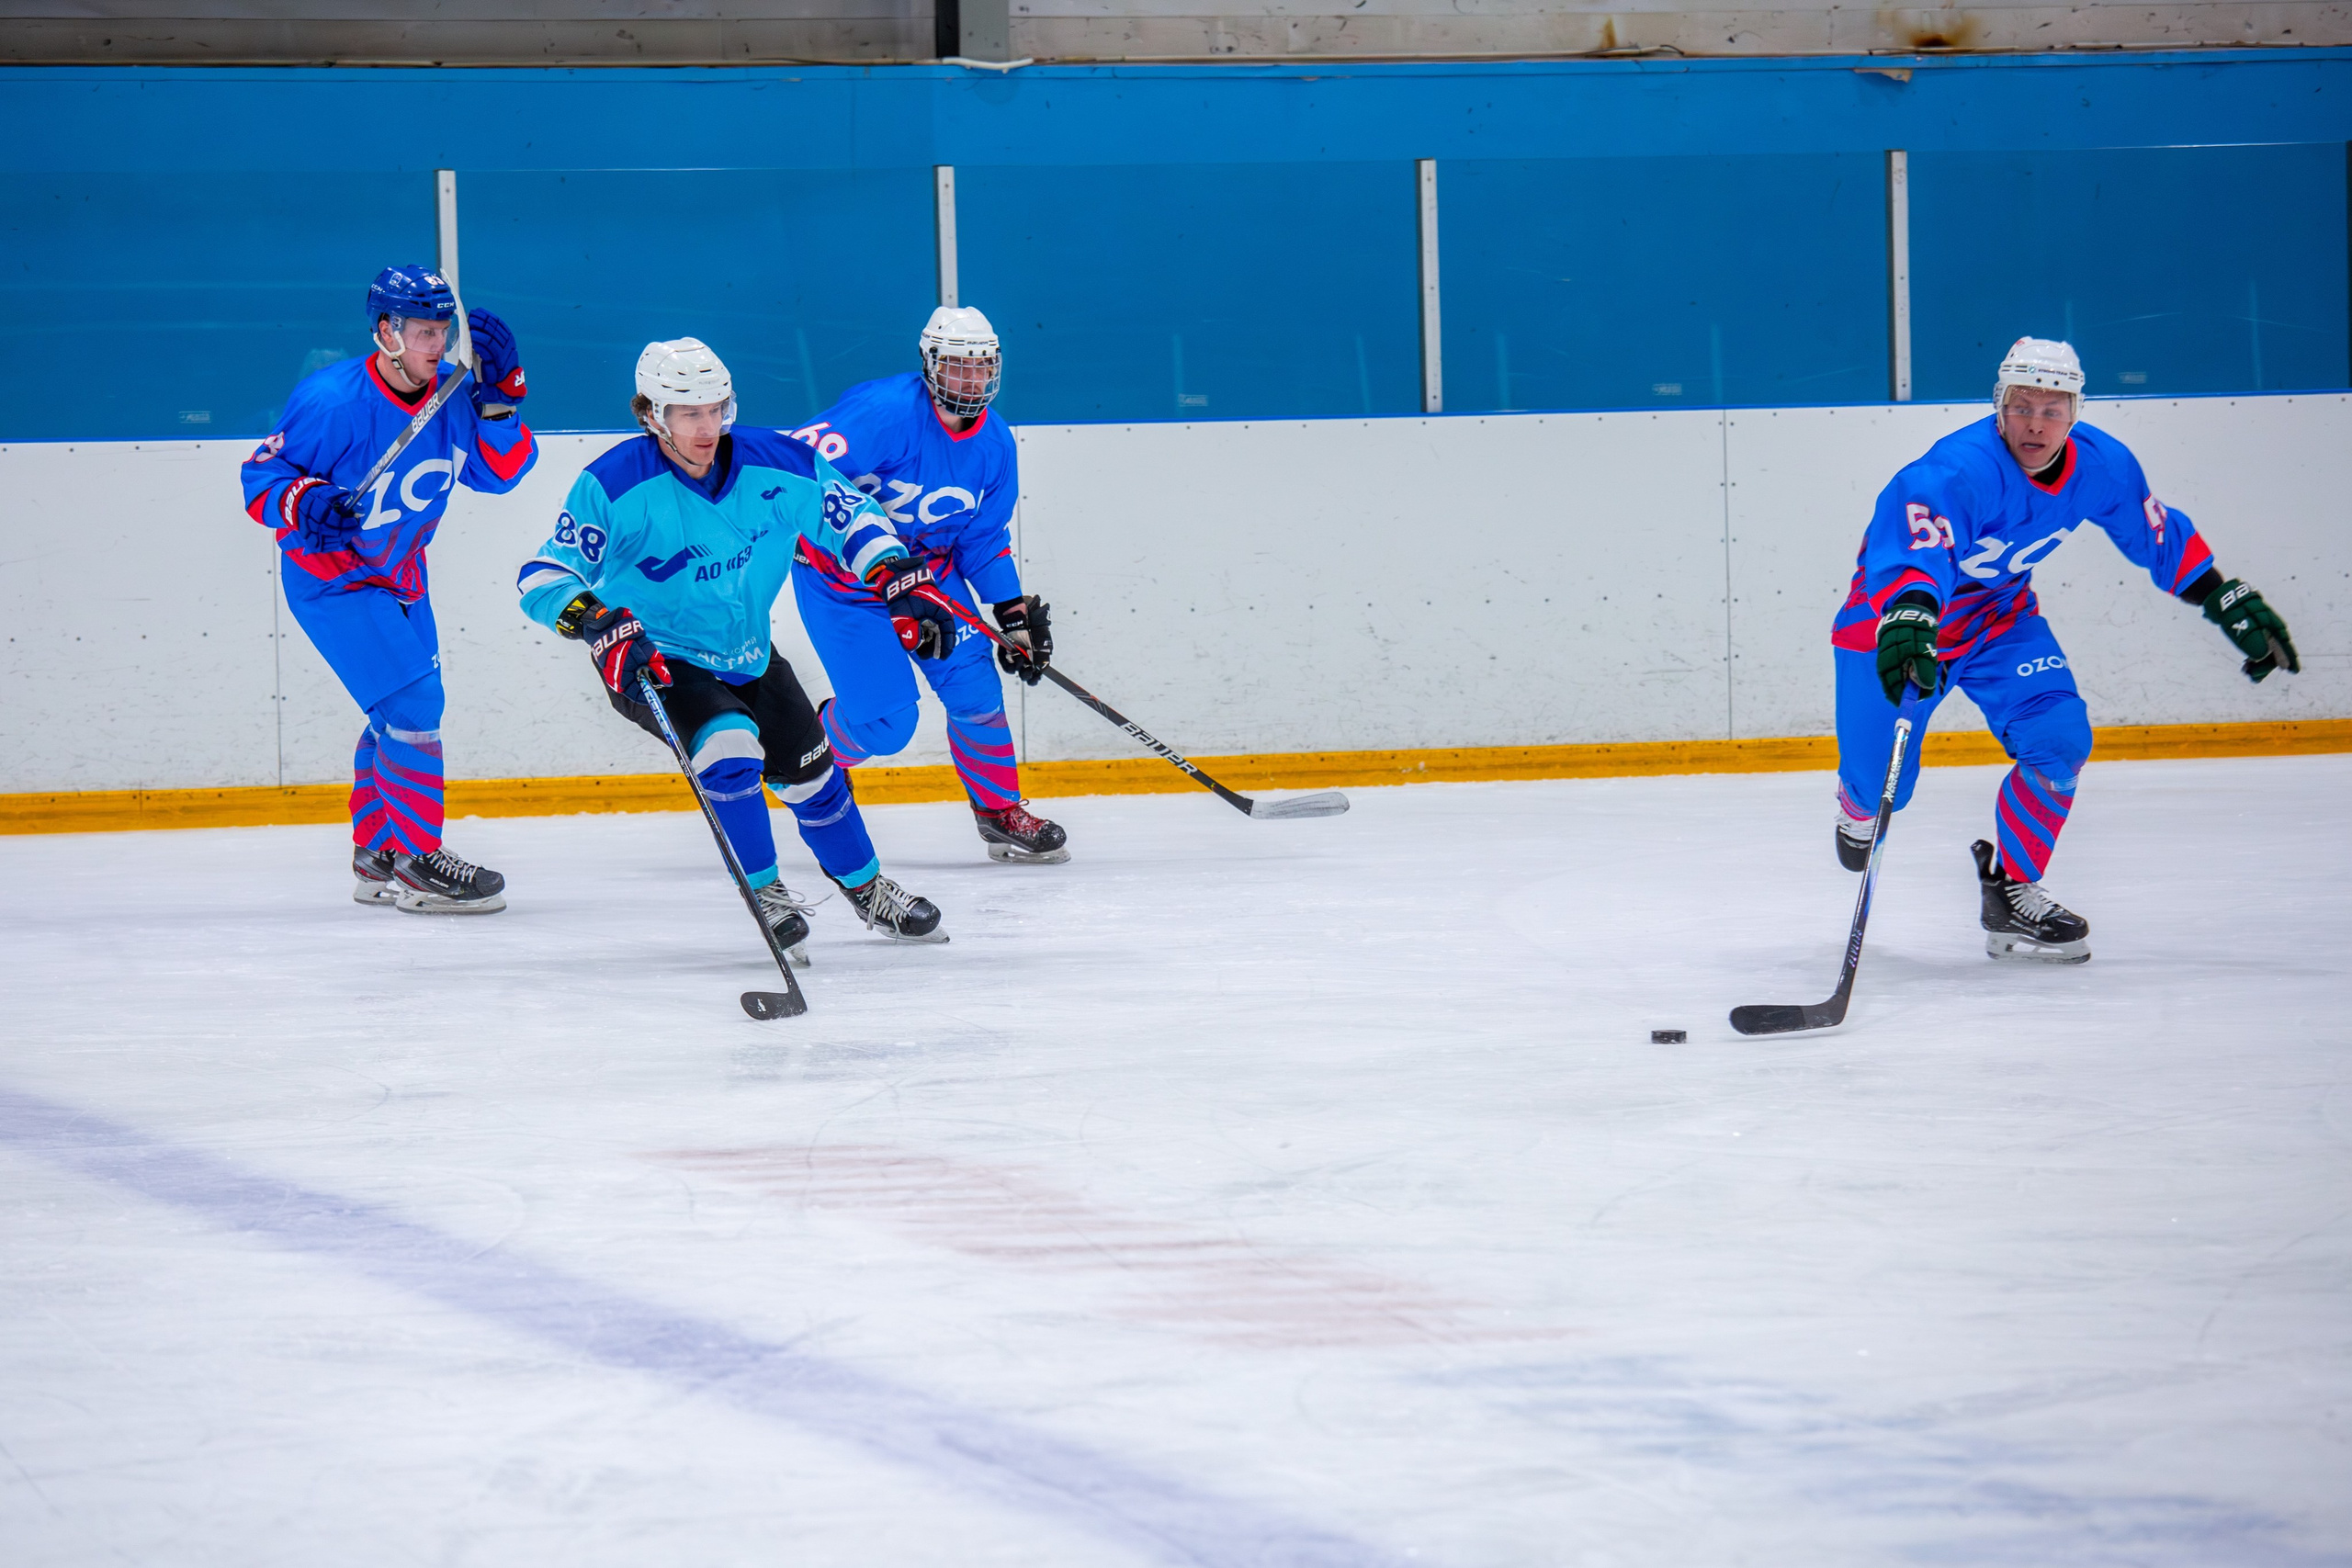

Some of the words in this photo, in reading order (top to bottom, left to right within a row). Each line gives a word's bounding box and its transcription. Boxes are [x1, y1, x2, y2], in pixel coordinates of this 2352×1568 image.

[412, 392, 440, 433] BAUER
[553, 510, 607, 564] 88
[695, 561, 721, 583] АО
[1120, 722, 1198, 775] BAUER
